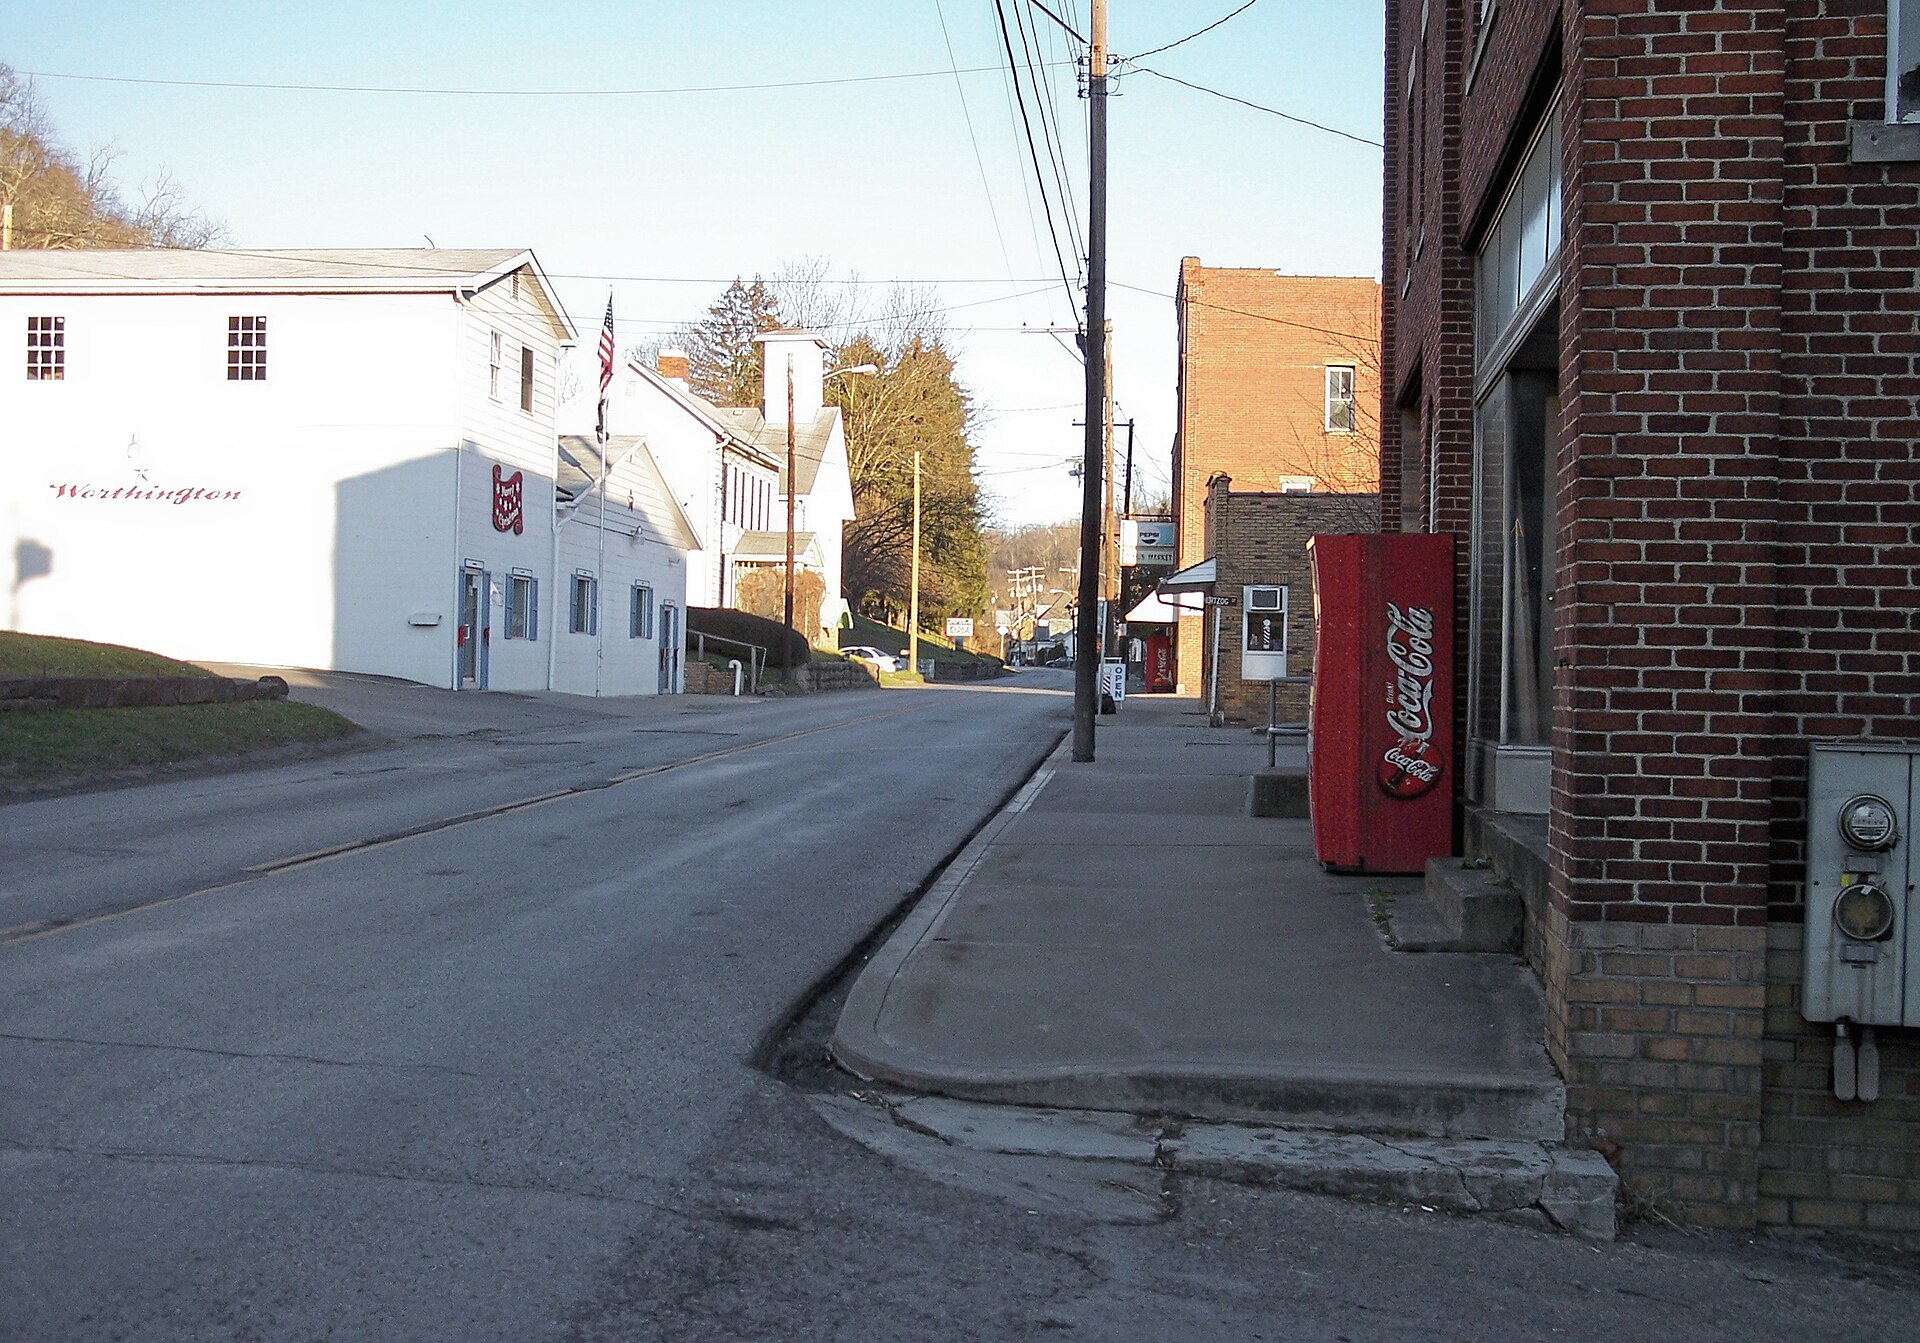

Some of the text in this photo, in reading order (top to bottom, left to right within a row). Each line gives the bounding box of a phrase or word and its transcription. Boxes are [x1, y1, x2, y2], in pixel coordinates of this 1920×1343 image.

[49, 483, 242, 504] Worthington
[501, 484, 515, 498] Merry
[498, 507, 519, 529] Christmas
[1114, 666, 1123, 698] OPEN
[1386, 601, 1434, 740] Coca-Cola
[1384, 746, 1440, 783] Coca-Cola
